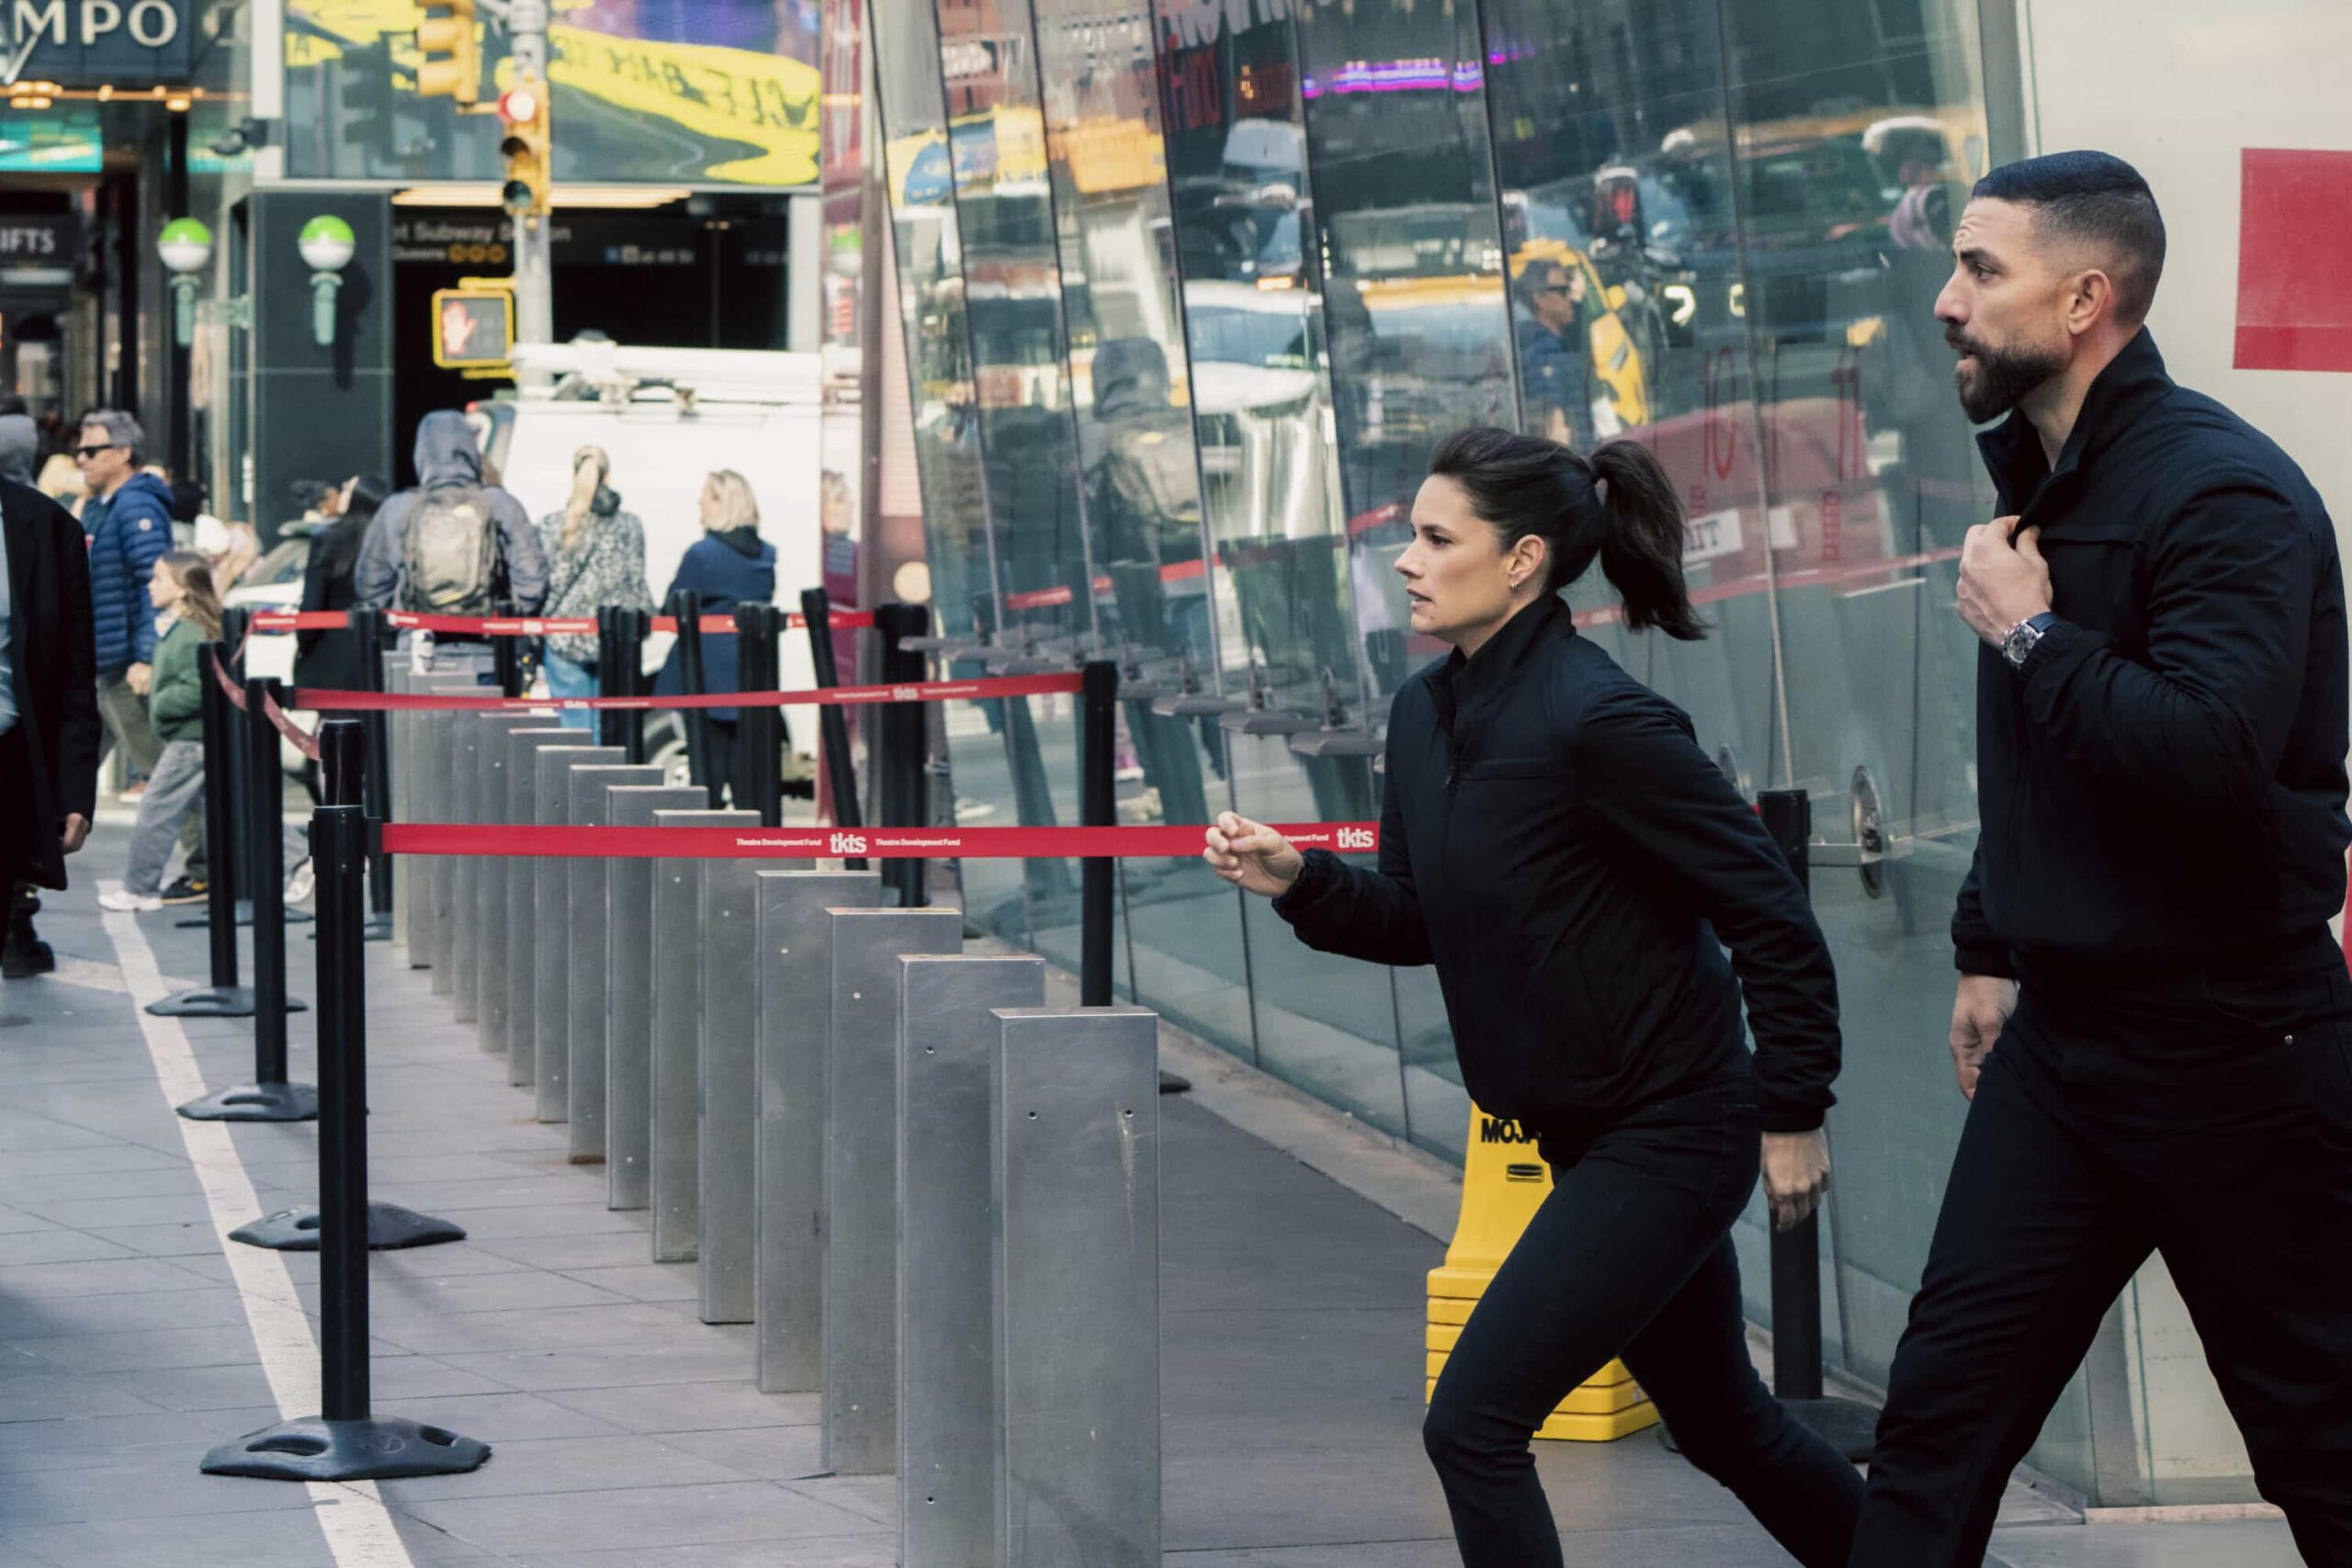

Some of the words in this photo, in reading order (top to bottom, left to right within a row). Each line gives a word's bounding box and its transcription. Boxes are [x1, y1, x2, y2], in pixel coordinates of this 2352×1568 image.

[14, 0, 178, 46] MPO
[737, 838, 761, 846] Theatre
[762, 838, 804, 847] Development
[805, 838, 822, 846] Fund
[830, 832, 866, 854] tkts
[876, 838, 899, 846] Theatre
[900, 838, 943, 847] Development
[944, 838, 961, 846] Fund
[1337, 827, 1374, 849] tkts
[1481, 1118, 1532, 1145] MOJ
